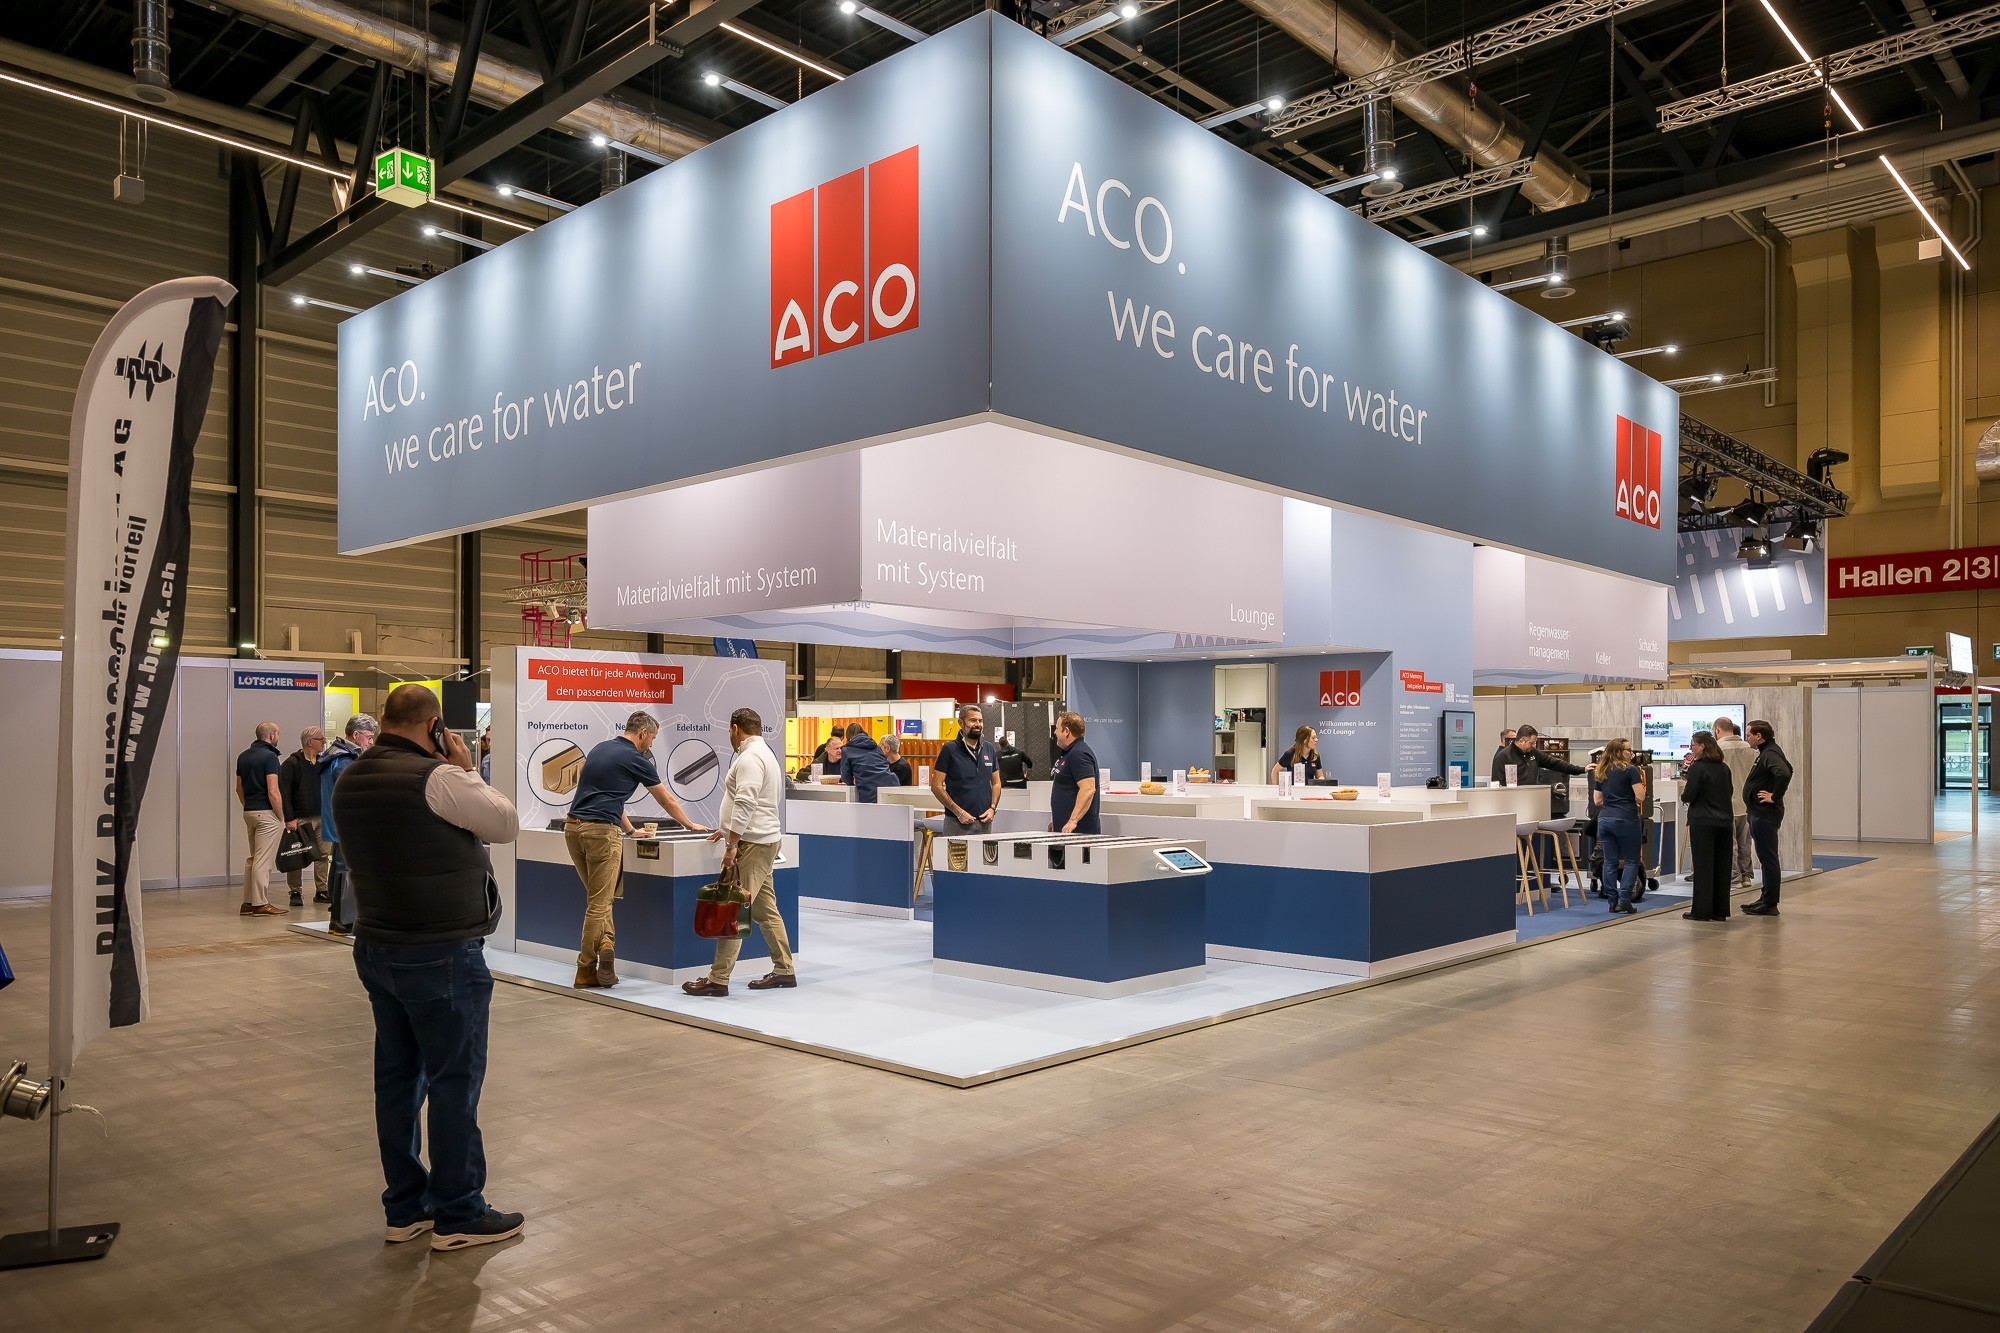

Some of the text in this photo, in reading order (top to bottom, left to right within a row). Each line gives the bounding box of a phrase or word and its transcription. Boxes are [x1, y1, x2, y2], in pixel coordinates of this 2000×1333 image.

[1057, 161, 1186, 275] ACO.
[774, 263, 916, 361] ACO
[1107, 290, 1428, 445] we care for water
[362, 359, 426, 421] ACO.
[384, 361, 642, 475] we care for water
[1616, 478, 1660, 525] ACO
[877, 518, 1018, 562] Materialvielfalt
[616, 566, 817, 607] Materialvielfalt mit System
[877, 559, 985, 594] mit System
[1839, 563, 1932, 589] Hallen
[1230, 602, 1275, 631] Lounge
[1528, 621, 1571, 641] Regenwasser-
[1528, 645, 1570, 662] management
[1595, 651, 1612, 665] Keller
[1638, 638, 1660, 653] Schacht-
[123, 561, 177, 763] www.bmk.ch
[537, 665, 676, 682] ACO bietet für jede Anwendung
[1638, 656, 1665, 672] kompetenz
[556, 686, 666, 699] den passenden Werkstoff
[1320, 692, 1360, 706] ACO
[527, 721, 589, 732] Polymerbeton
[676, 723, 711, 732] Edelstahl
